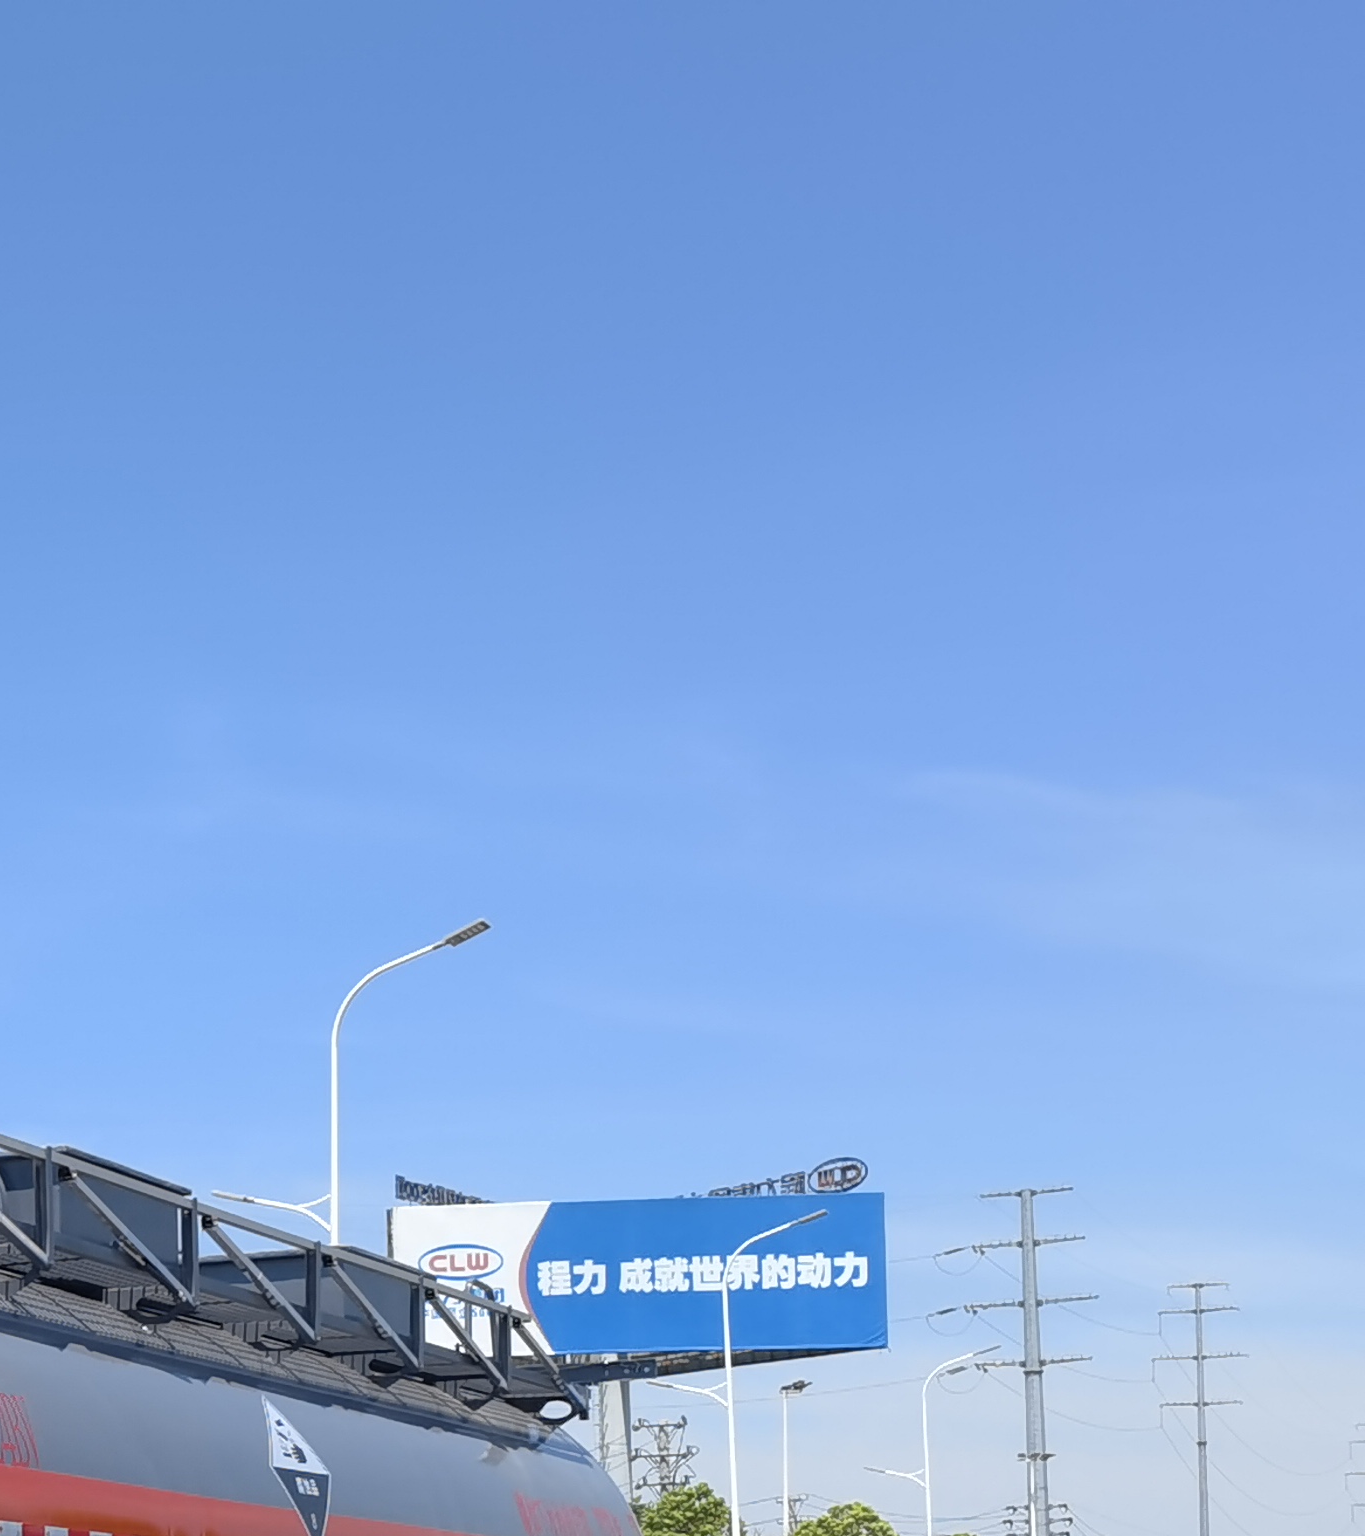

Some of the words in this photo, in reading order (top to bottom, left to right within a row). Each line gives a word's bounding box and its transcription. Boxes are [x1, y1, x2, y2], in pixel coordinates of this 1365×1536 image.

[428, 1252, 489, 1272] CLW
[537, 1260, 607, 1296] 程力
[619, 1252, 869, 1293] 成就世界的动力
